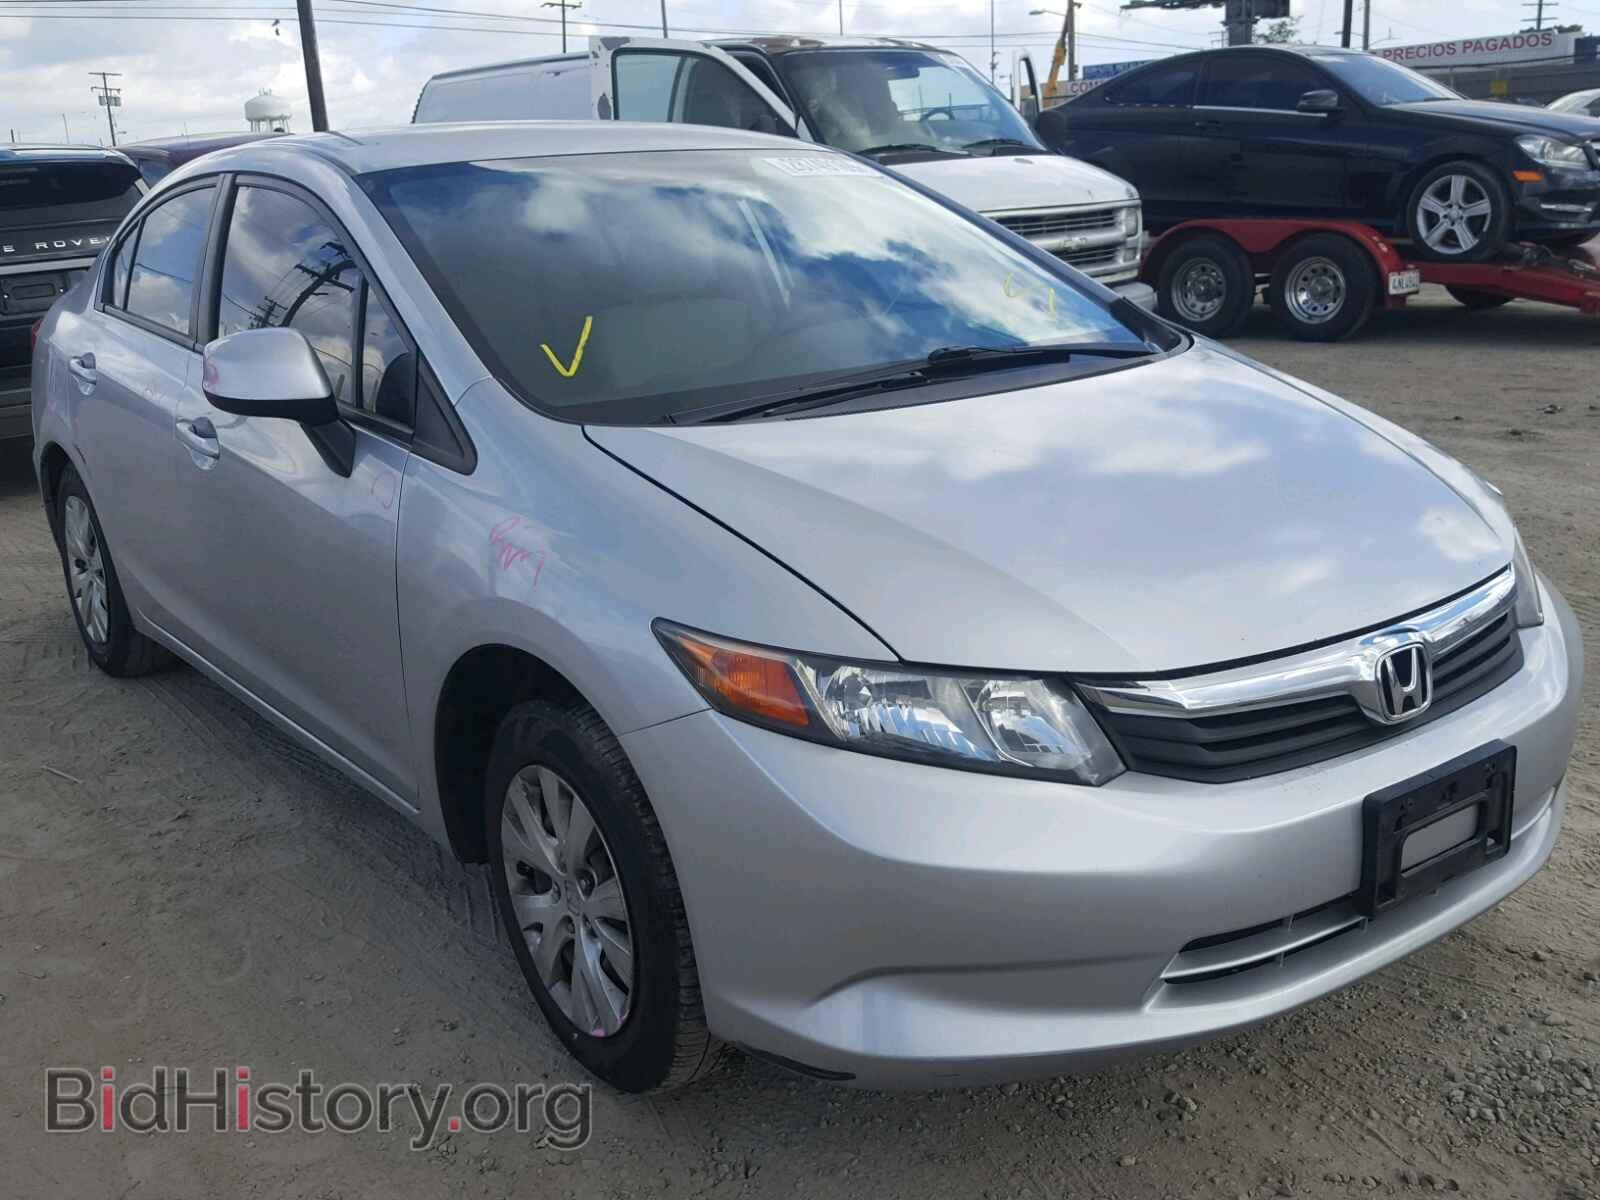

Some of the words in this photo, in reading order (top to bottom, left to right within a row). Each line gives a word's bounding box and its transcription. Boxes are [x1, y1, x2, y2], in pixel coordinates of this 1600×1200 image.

[1382, 42, 1457, 61] PRECIOS
[1462, 32, 1553, 54] PAGADOS
[34, 236, 111, 249] ROVE
